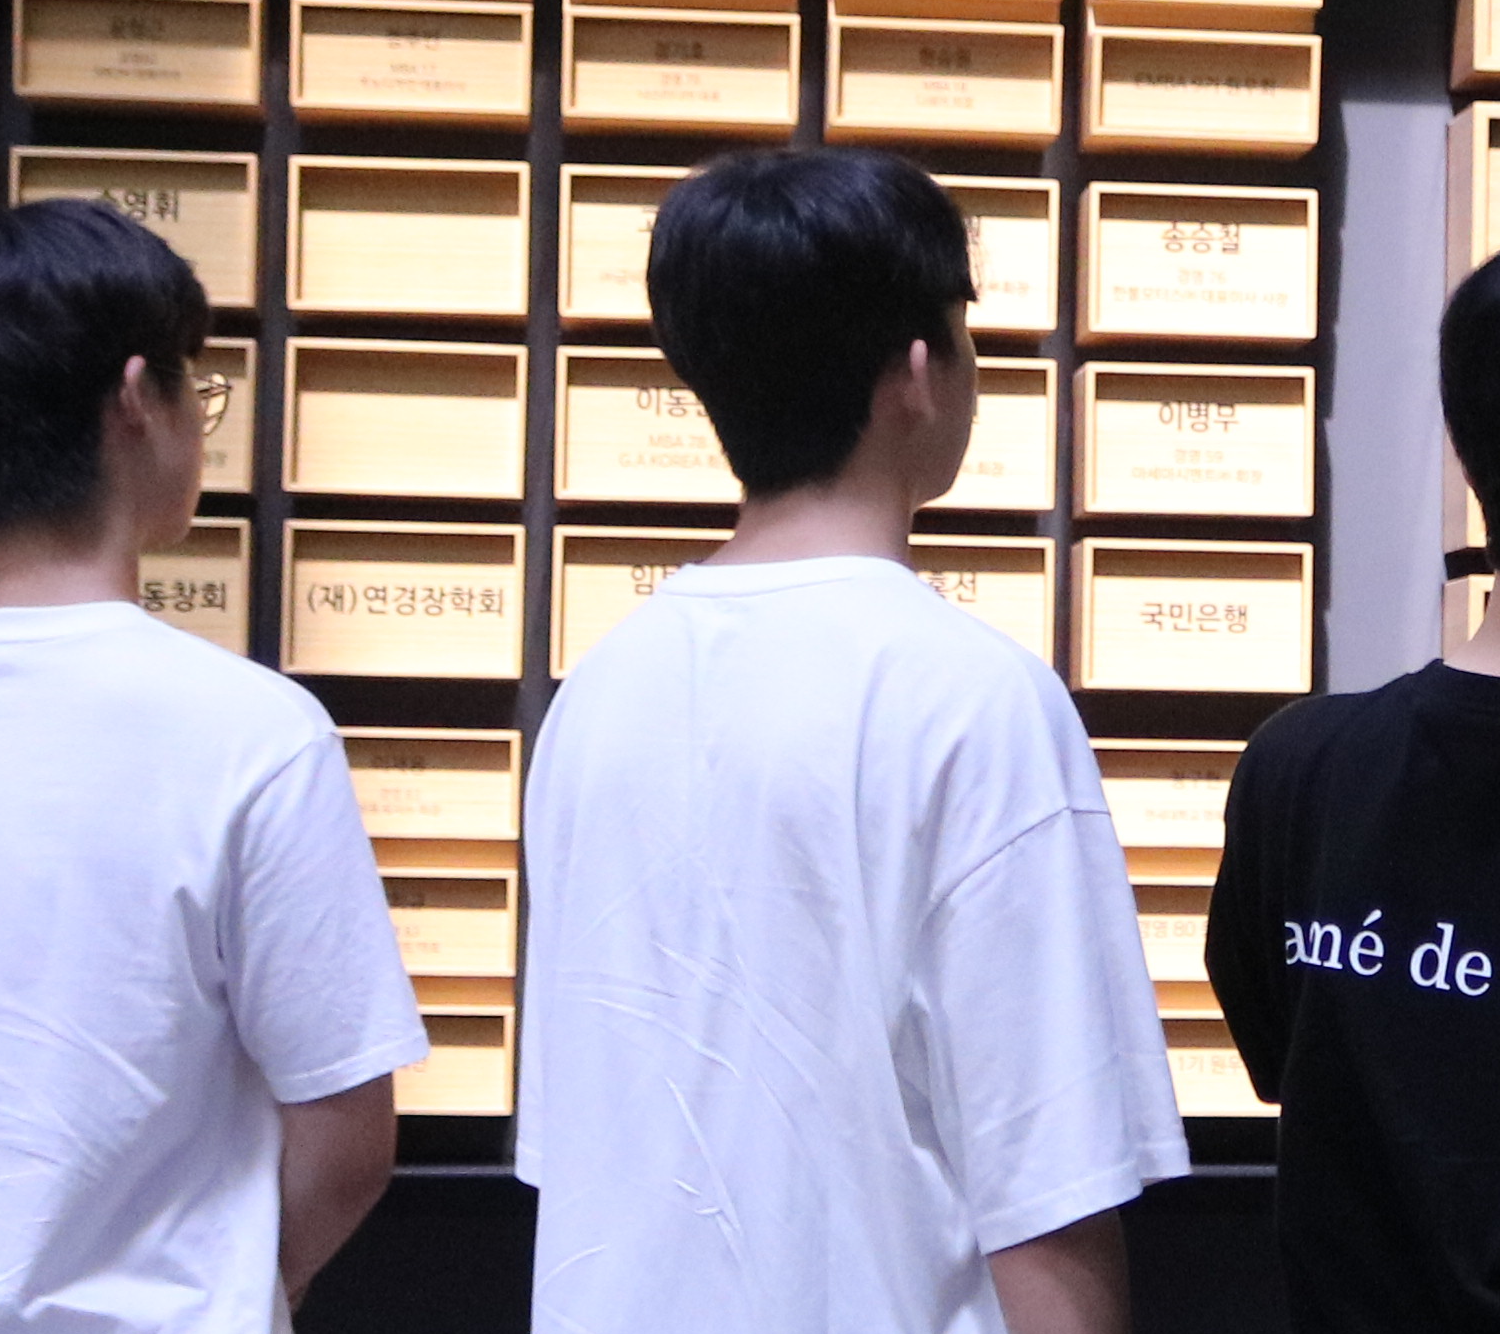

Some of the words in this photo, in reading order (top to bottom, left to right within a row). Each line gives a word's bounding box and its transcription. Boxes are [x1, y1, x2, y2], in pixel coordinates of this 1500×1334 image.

[1158, 399, 1241, 433] 이병부
[648, 434, 684, 449] MBA
[1139, 600, 1250, 635] 국민은행
[1409, 921, 1493, 997] de
